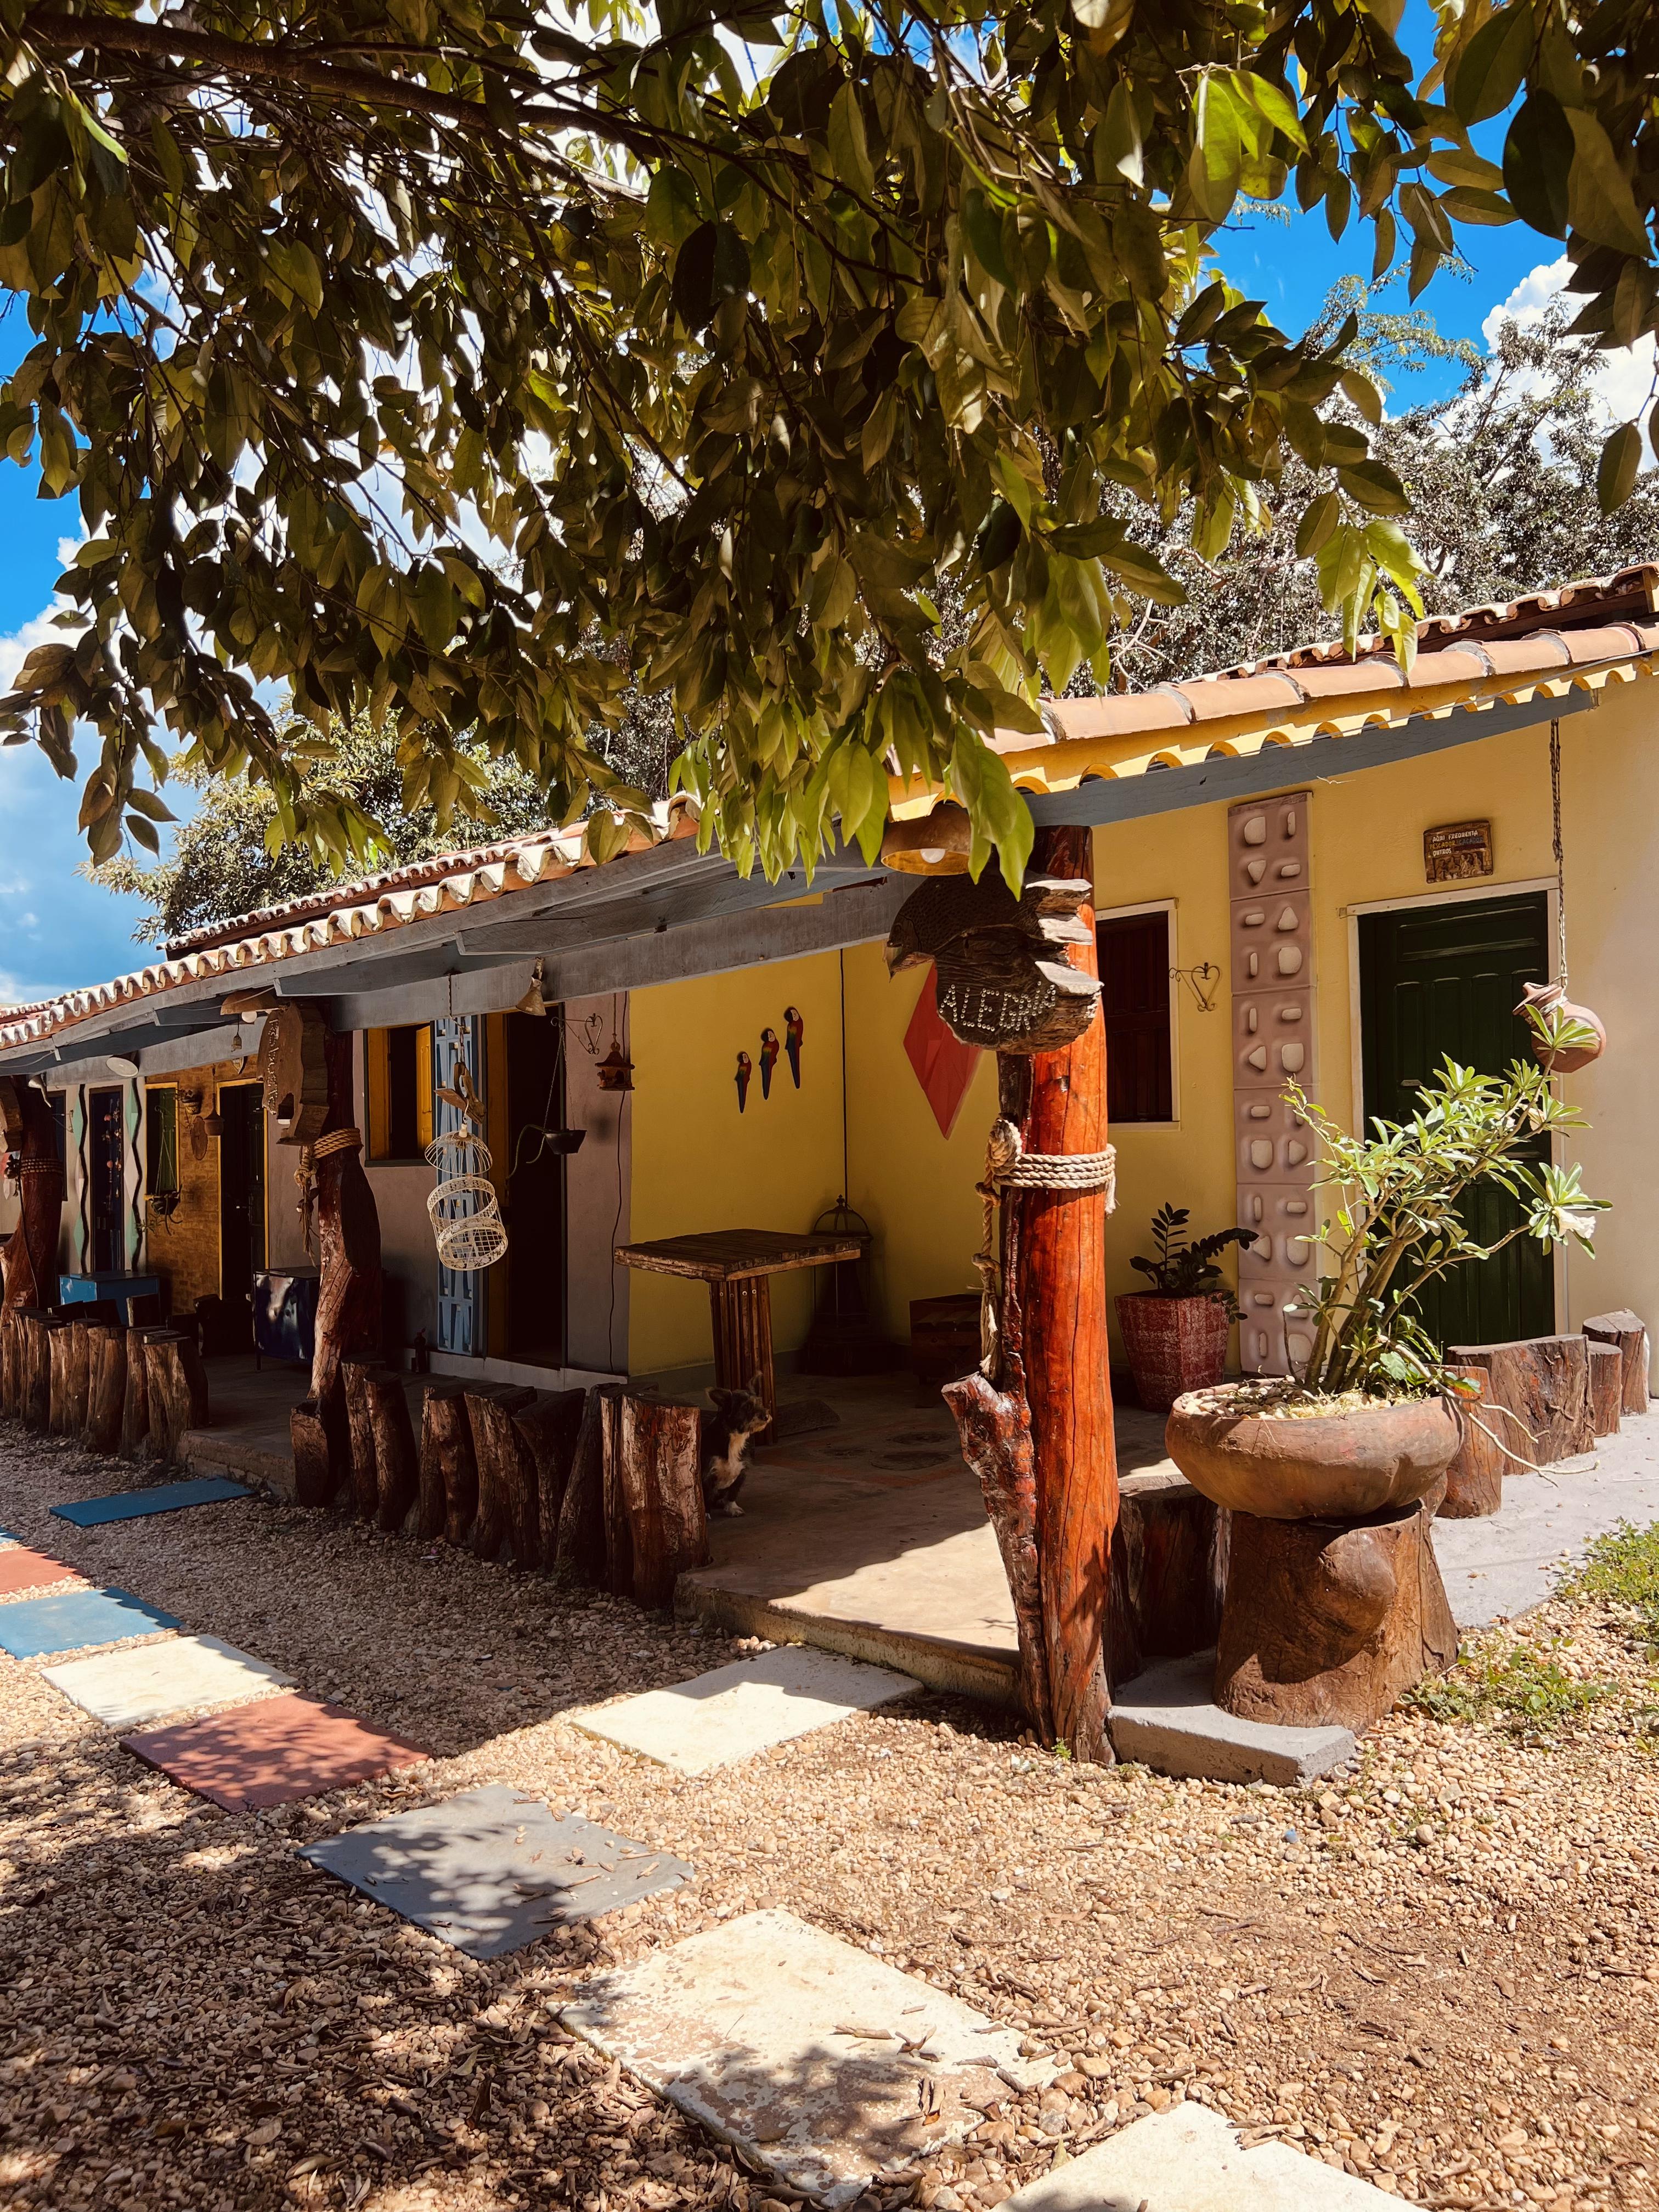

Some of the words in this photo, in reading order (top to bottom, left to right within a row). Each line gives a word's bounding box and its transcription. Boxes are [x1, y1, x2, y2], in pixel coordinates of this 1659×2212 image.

[1448, 830, 1478, 840] FREQUENTA
[1432, 848, 1452, 857] OUTROS
[939, 980, 1056, 1031] ALEGRIA
